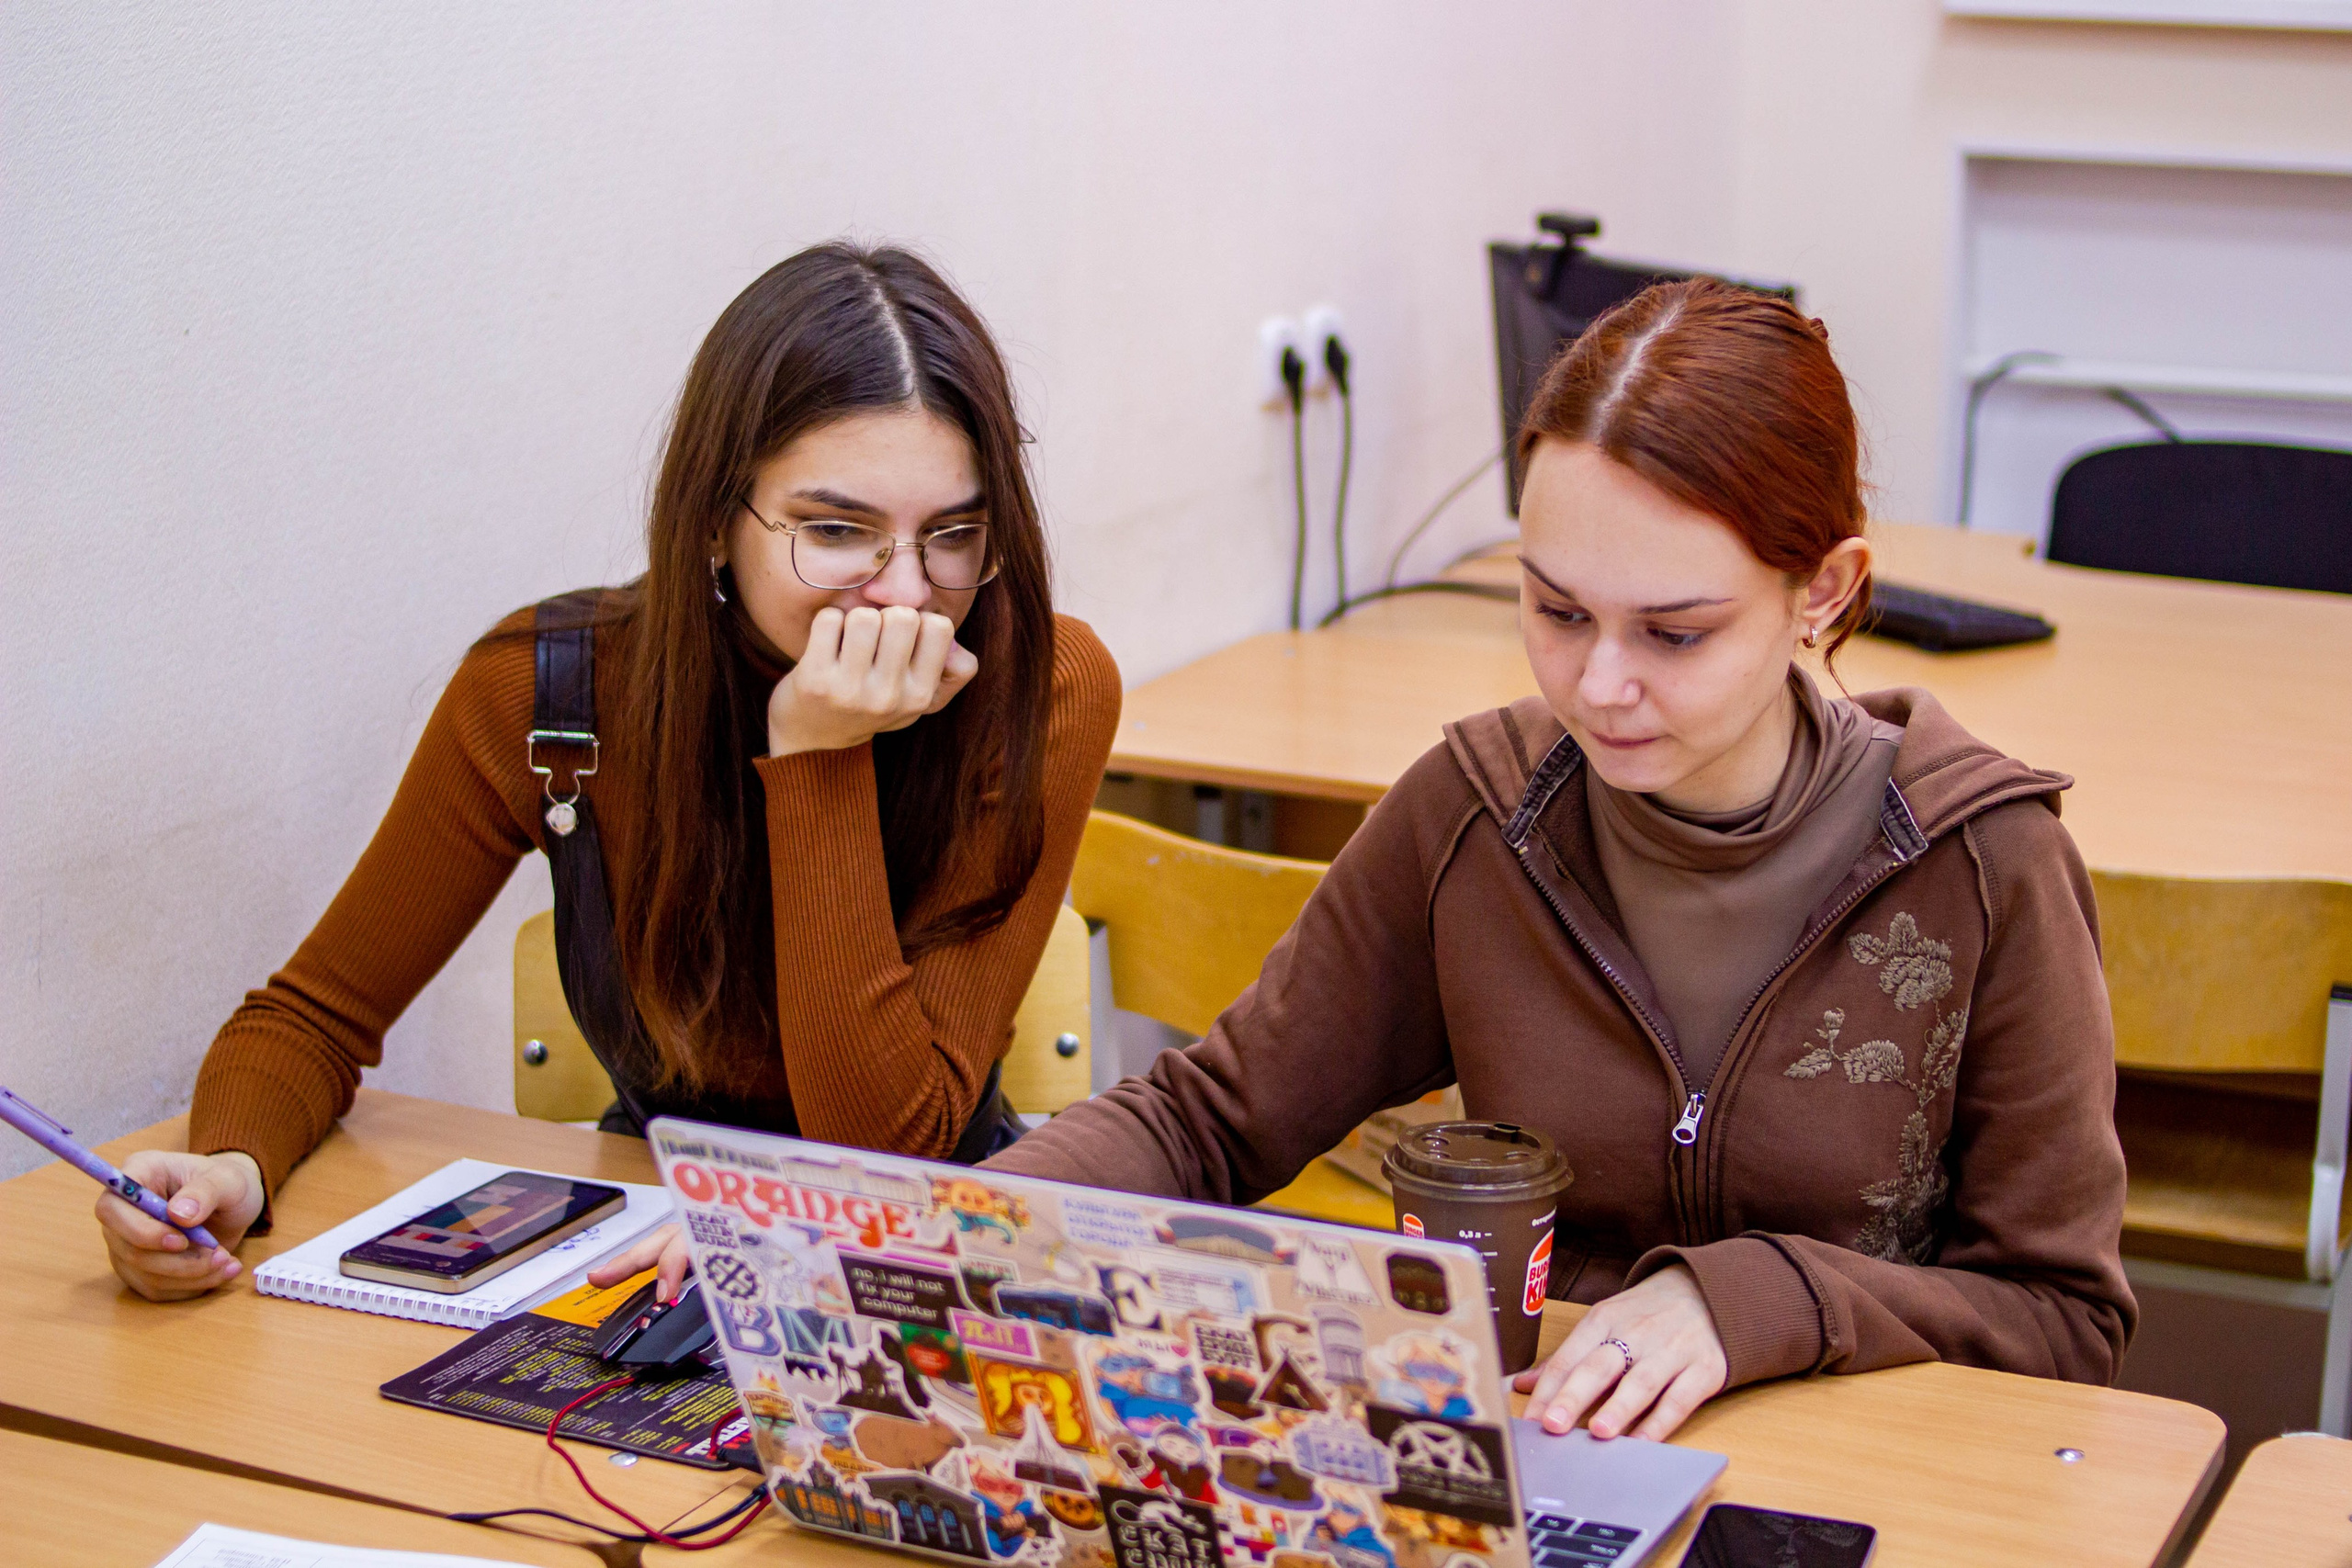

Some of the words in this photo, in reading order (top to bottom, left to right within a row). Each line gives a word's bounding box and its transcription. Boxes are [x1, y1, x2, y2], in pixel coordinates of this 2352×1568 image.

[673, 1162, 915, 1248] ORANGE
[1529, 1260, 1549, 1282] BUR
[855, 1280, 878, 1295] fix
[880, 1288, 917, 1303] your
[888, 1273, 915, 1287] will
[915, 1279, 946, 1296] not
[1526, 1277, 1547, 1304] KIN
[859, 1296, 939, 1320] computer
